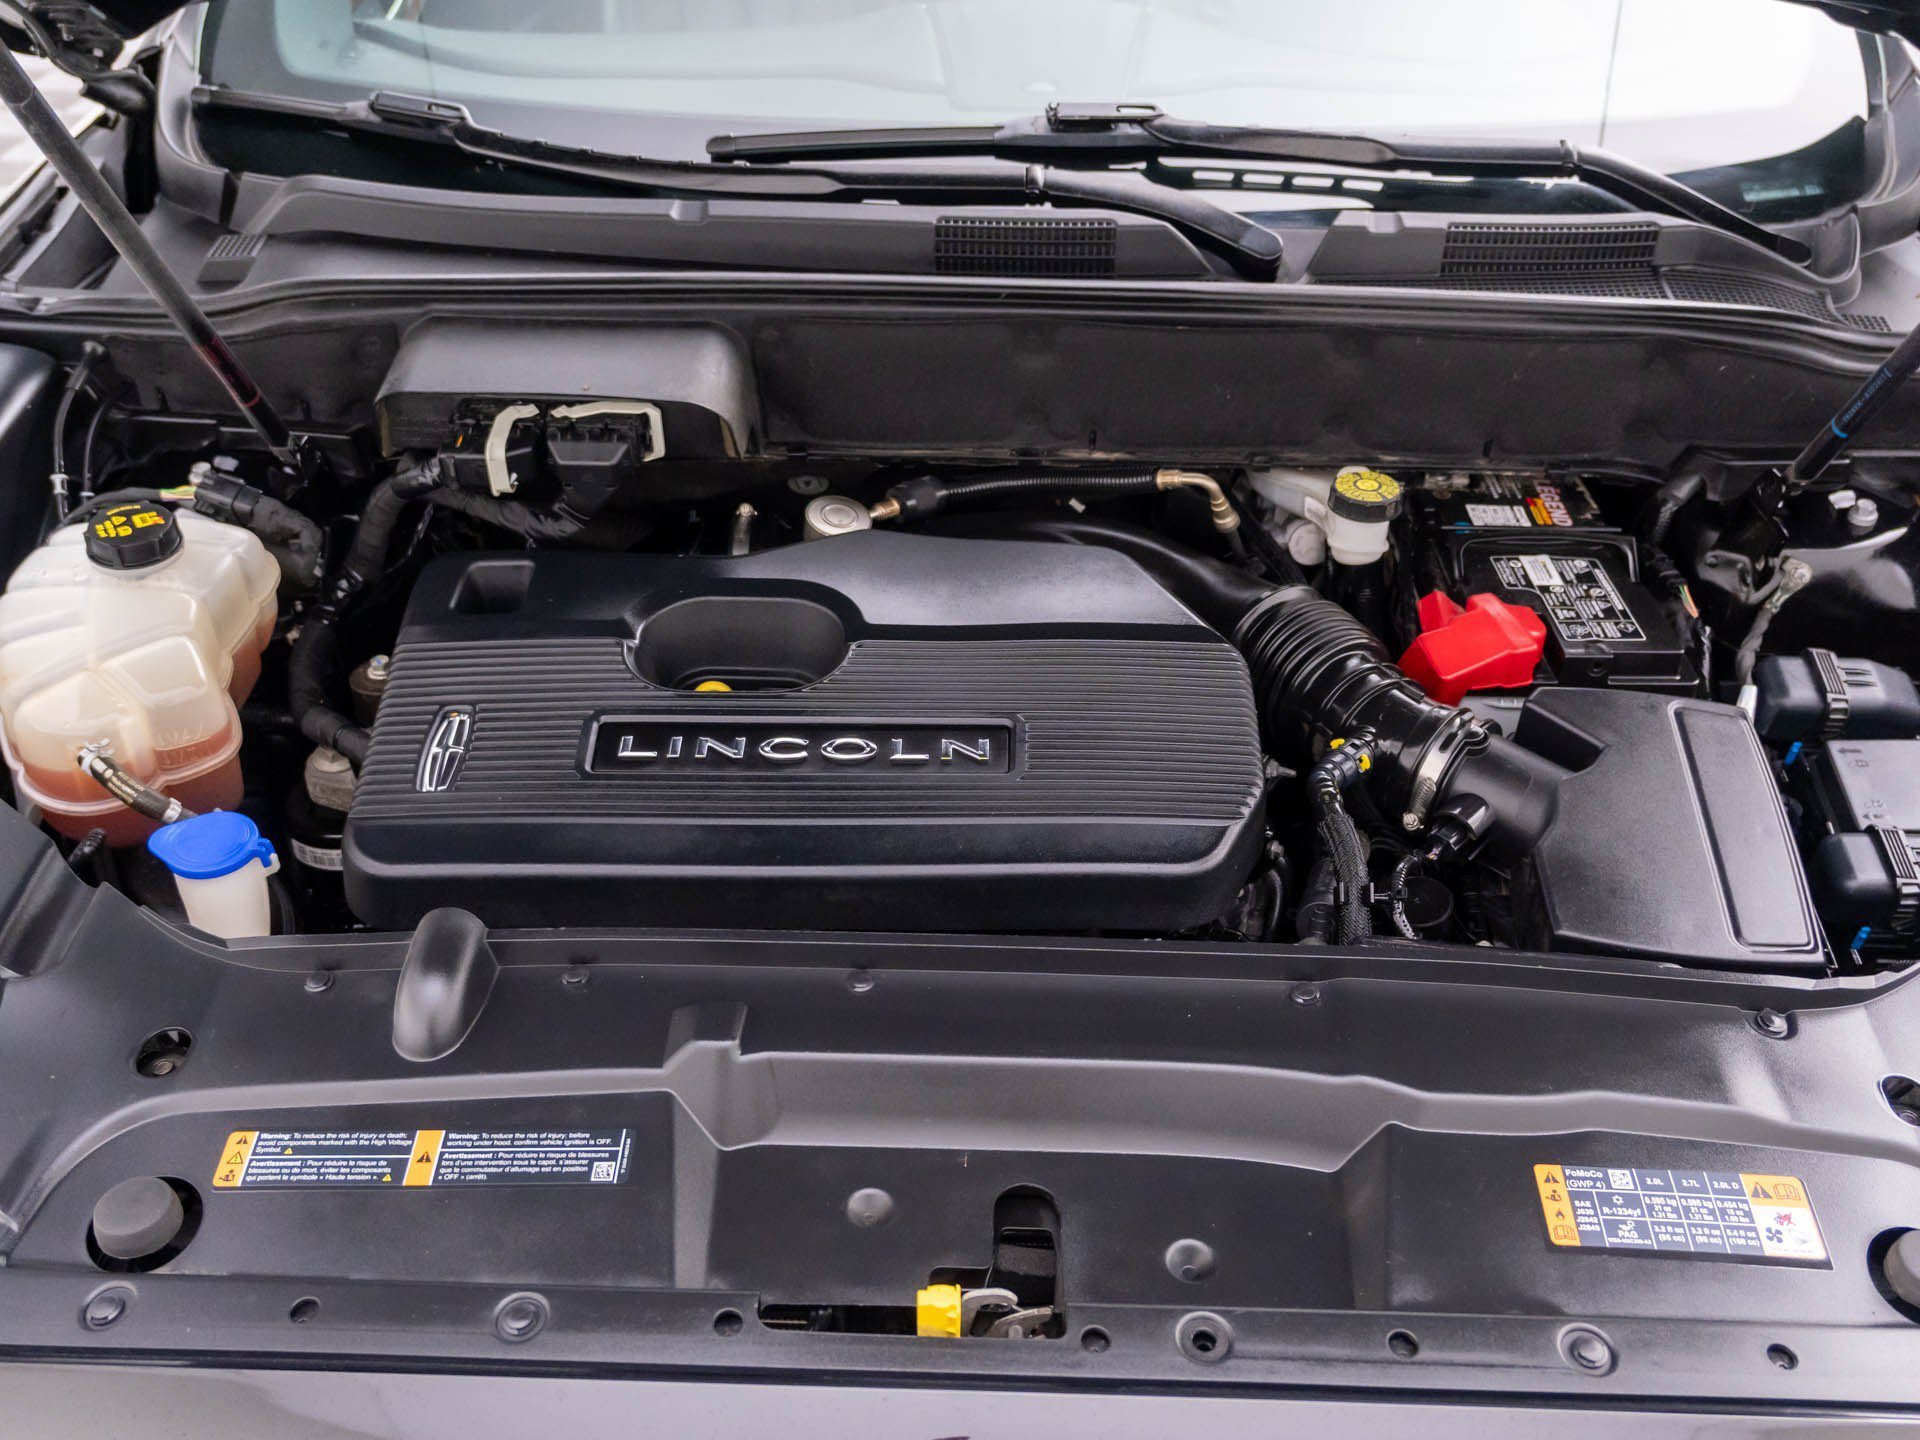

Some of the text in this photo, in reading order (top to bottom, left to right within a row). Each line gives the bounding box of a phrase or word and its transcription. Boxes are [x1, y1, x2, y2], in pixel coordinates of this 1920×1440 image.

[617, 735, 990, 763] LINCOLN
[261, 1133, 294, 1141] Warning:
[448, 1132, 481, 1141] Warning:
[563, 1139, 588, 1147] ignition
[546, 1152, 567, 1160] risque
[356, 1160, 377, 1168] risque
[1565, 1168, 1603, 1178] FoMoCo
[289, 1174, 318, 1182] symbole
[1566, 1179, 1606, 1190] (GWP 4)
[1574, 1200, 1592, 1208] SAE
[1602, 1206, 1641, 1217] R-1234yf
[1617, 1229, 1639, 1239] PAG
